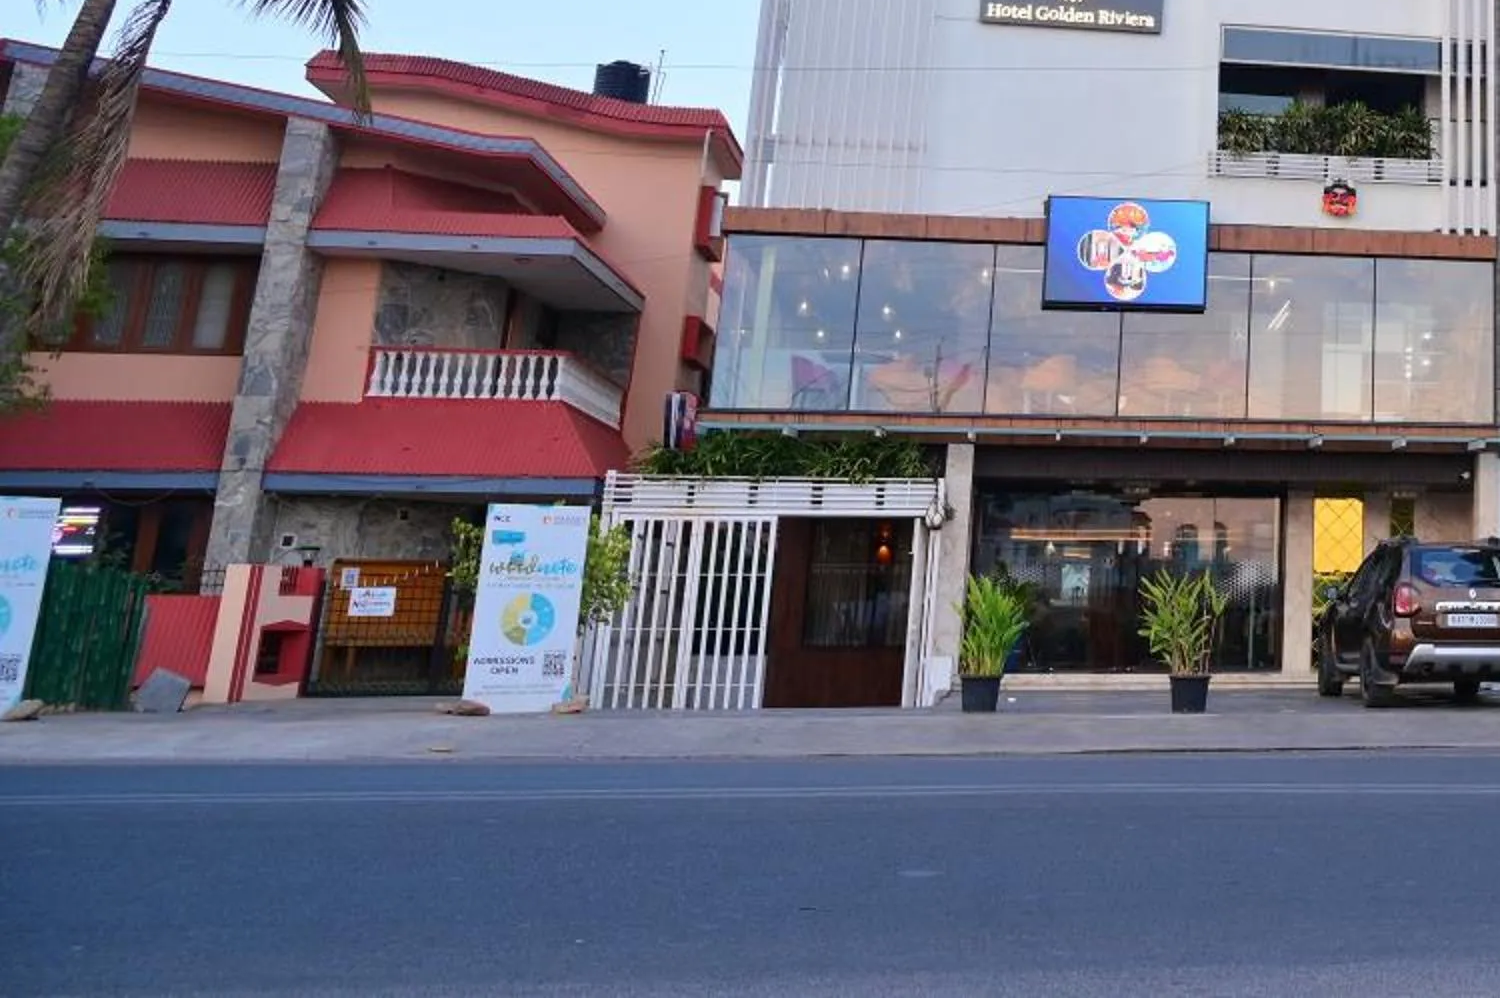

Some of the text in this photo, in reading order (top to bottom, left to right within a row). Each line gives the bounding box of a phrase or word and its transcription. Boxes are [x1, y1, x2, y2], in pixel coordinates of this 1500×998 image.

[987, 3, 1154, 27] Hotel Golden Riviera
[473, 656, 535, 665] ADMISSIONS
[489, 666, 519, 675] OPEN
